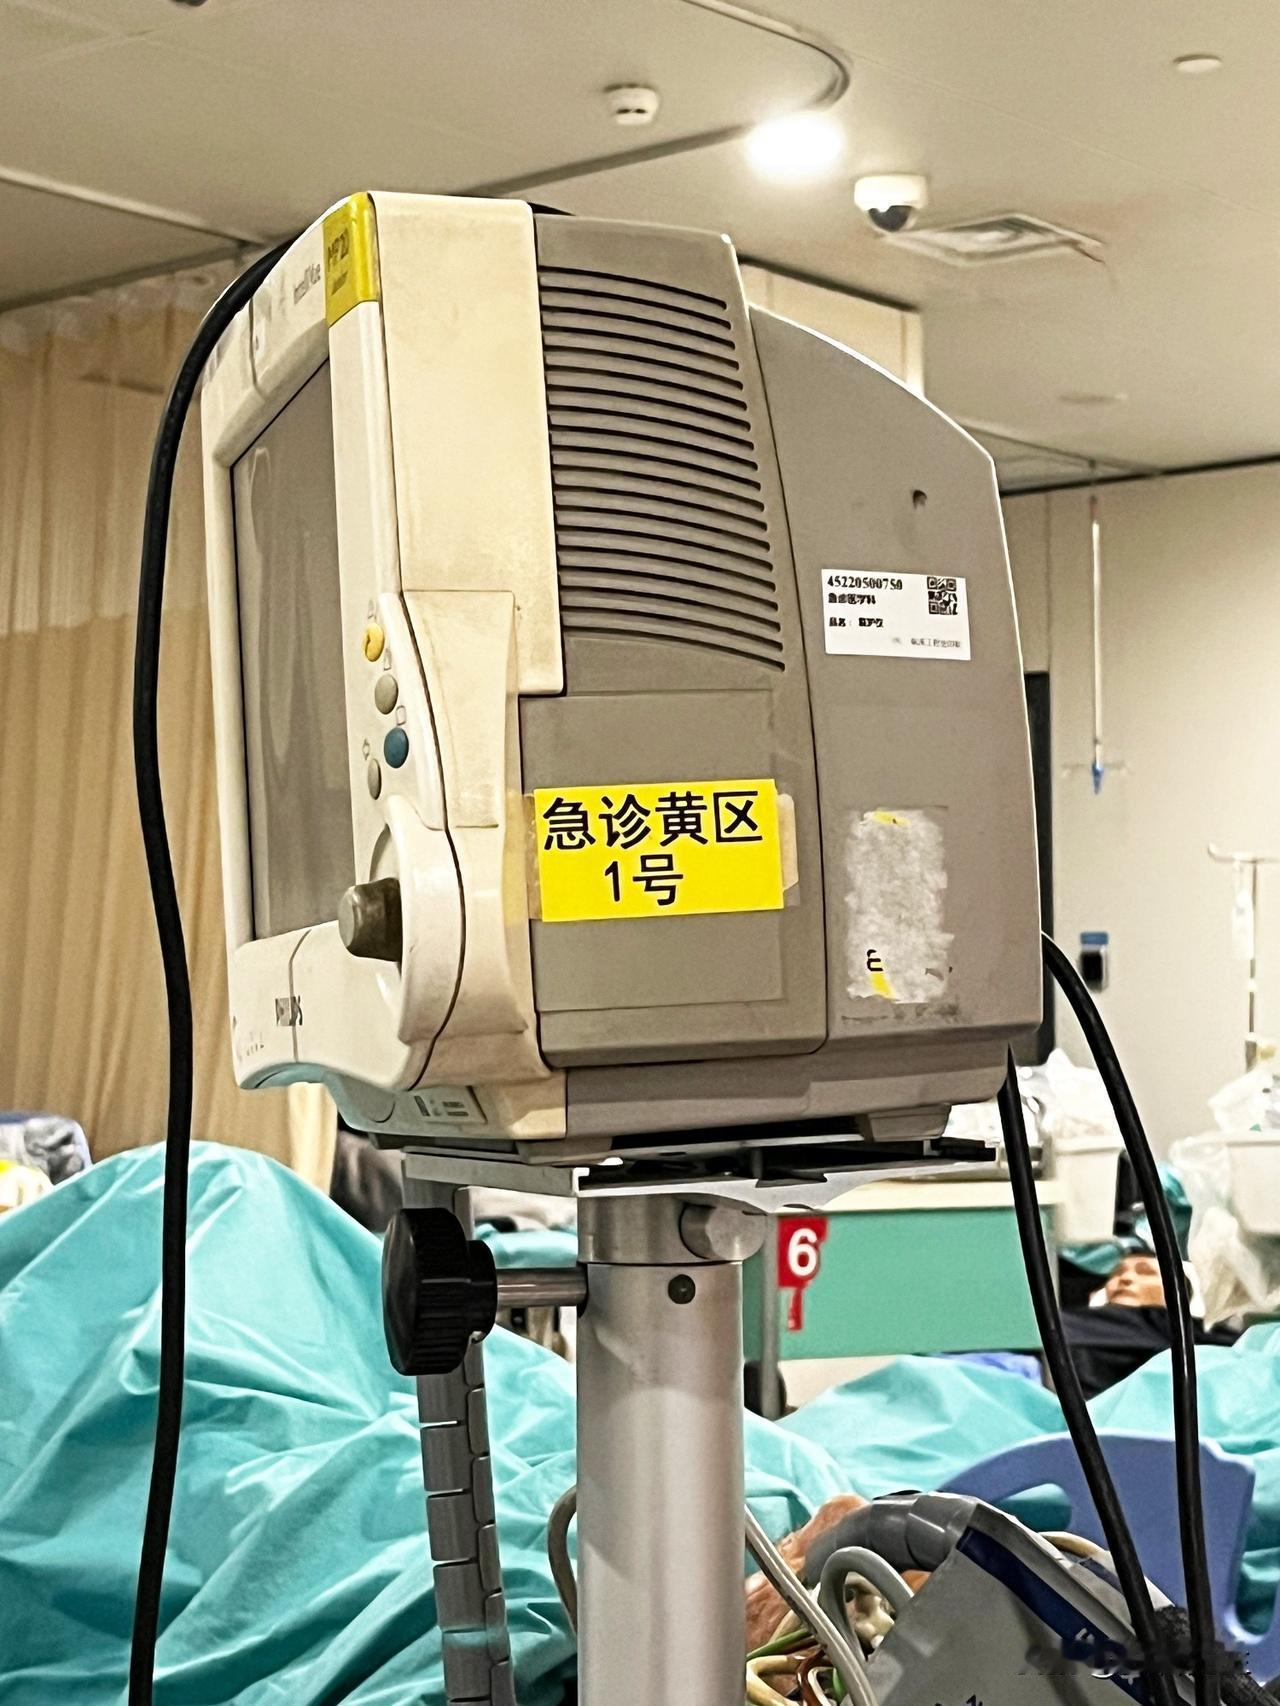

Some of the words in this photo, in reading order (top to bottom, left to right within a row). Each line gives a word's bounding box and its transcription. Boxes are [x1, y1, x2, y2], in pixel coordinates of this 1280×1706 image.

[827, 575, 903, 591] 45220500750
[542, 790, 763, 850] 急诊黄区
[604, 853, 684, 906] 1号
[788, 1227, 818, 1277] 6
